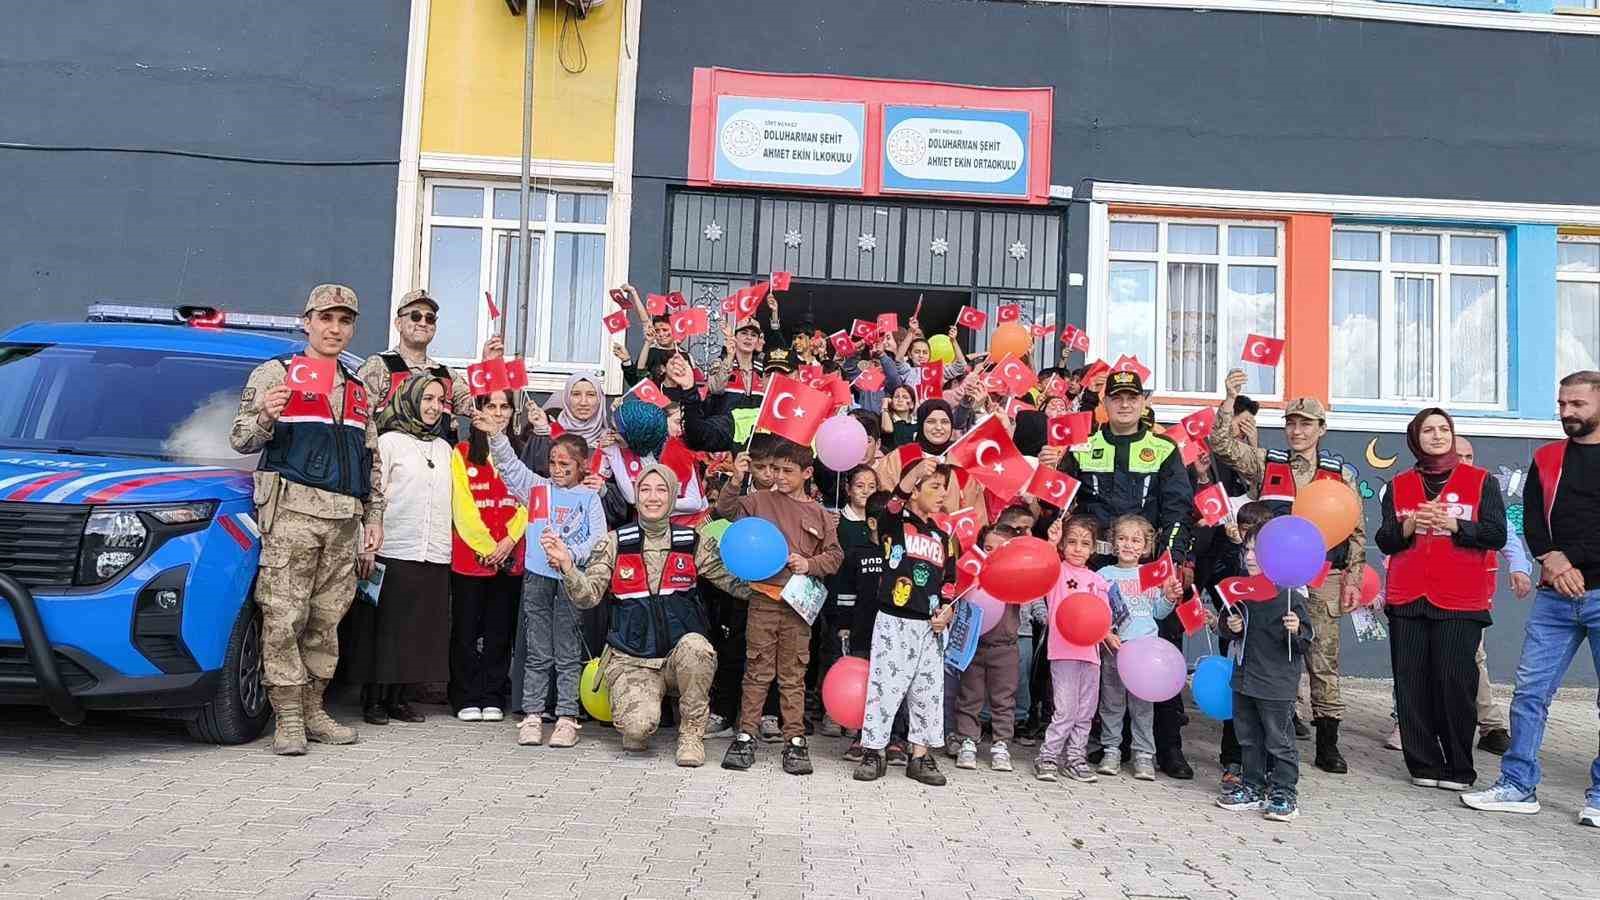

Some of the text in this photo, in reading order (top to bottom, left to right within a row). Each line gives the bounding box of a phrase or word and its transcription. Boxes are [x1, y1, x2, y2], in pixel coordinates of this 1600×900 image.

[764, 129, 842, 146] DOLUHARMAN ŞEHİT
[928, 138, 1001, 153] DOLUHARMAN ŞEHİT
[763, 148, 852, 163] AHMET EKİN İLKOKULU
[928, 156, 1017, 170] AHMET EKİN ORTAOKULU
